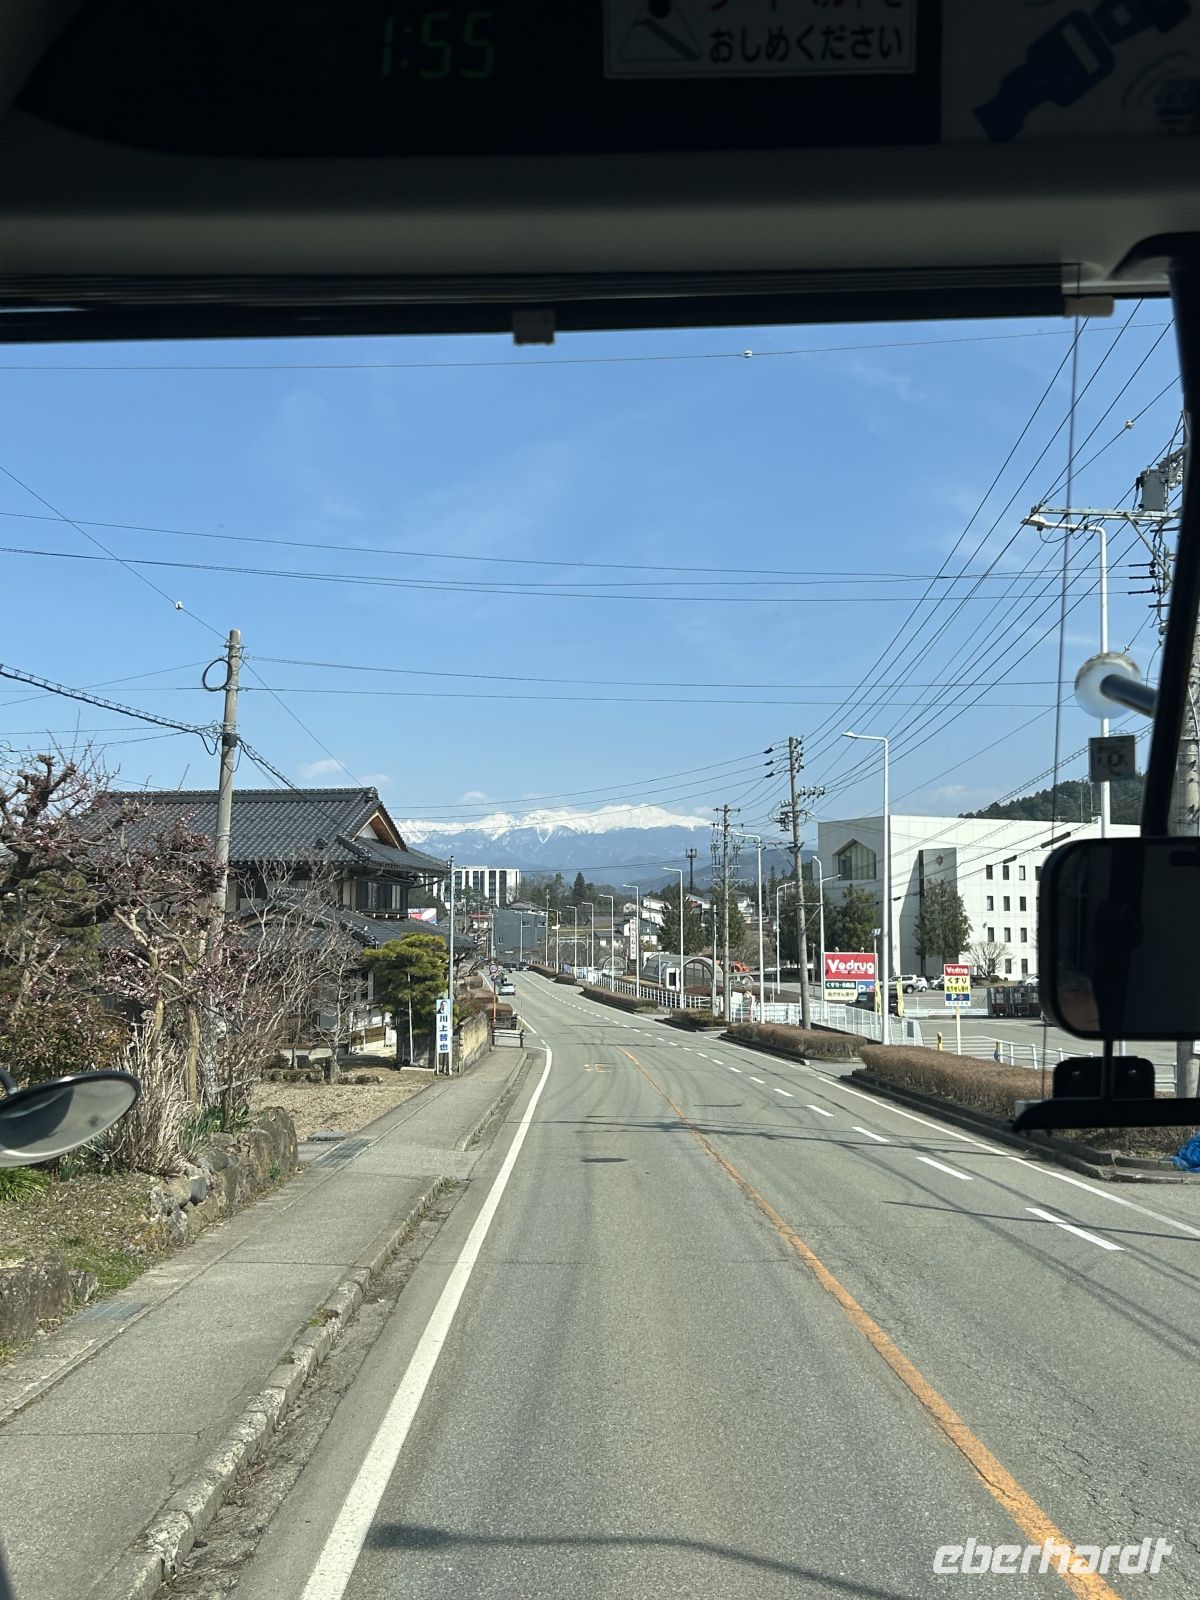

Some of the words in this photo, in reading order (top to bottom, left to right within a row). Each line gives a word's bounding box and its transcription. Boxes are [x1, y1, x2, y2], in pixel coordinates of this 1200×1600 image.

[382, 10, 496, 79] 1:55
[709, 24, 904, 63] おしめください
[827, 959, 875, 975] Vedrug
[945, 966, 969, 975] Vedrug
[947, 976, 967, 985] くすり
[951, 993, 957, 1001] P
